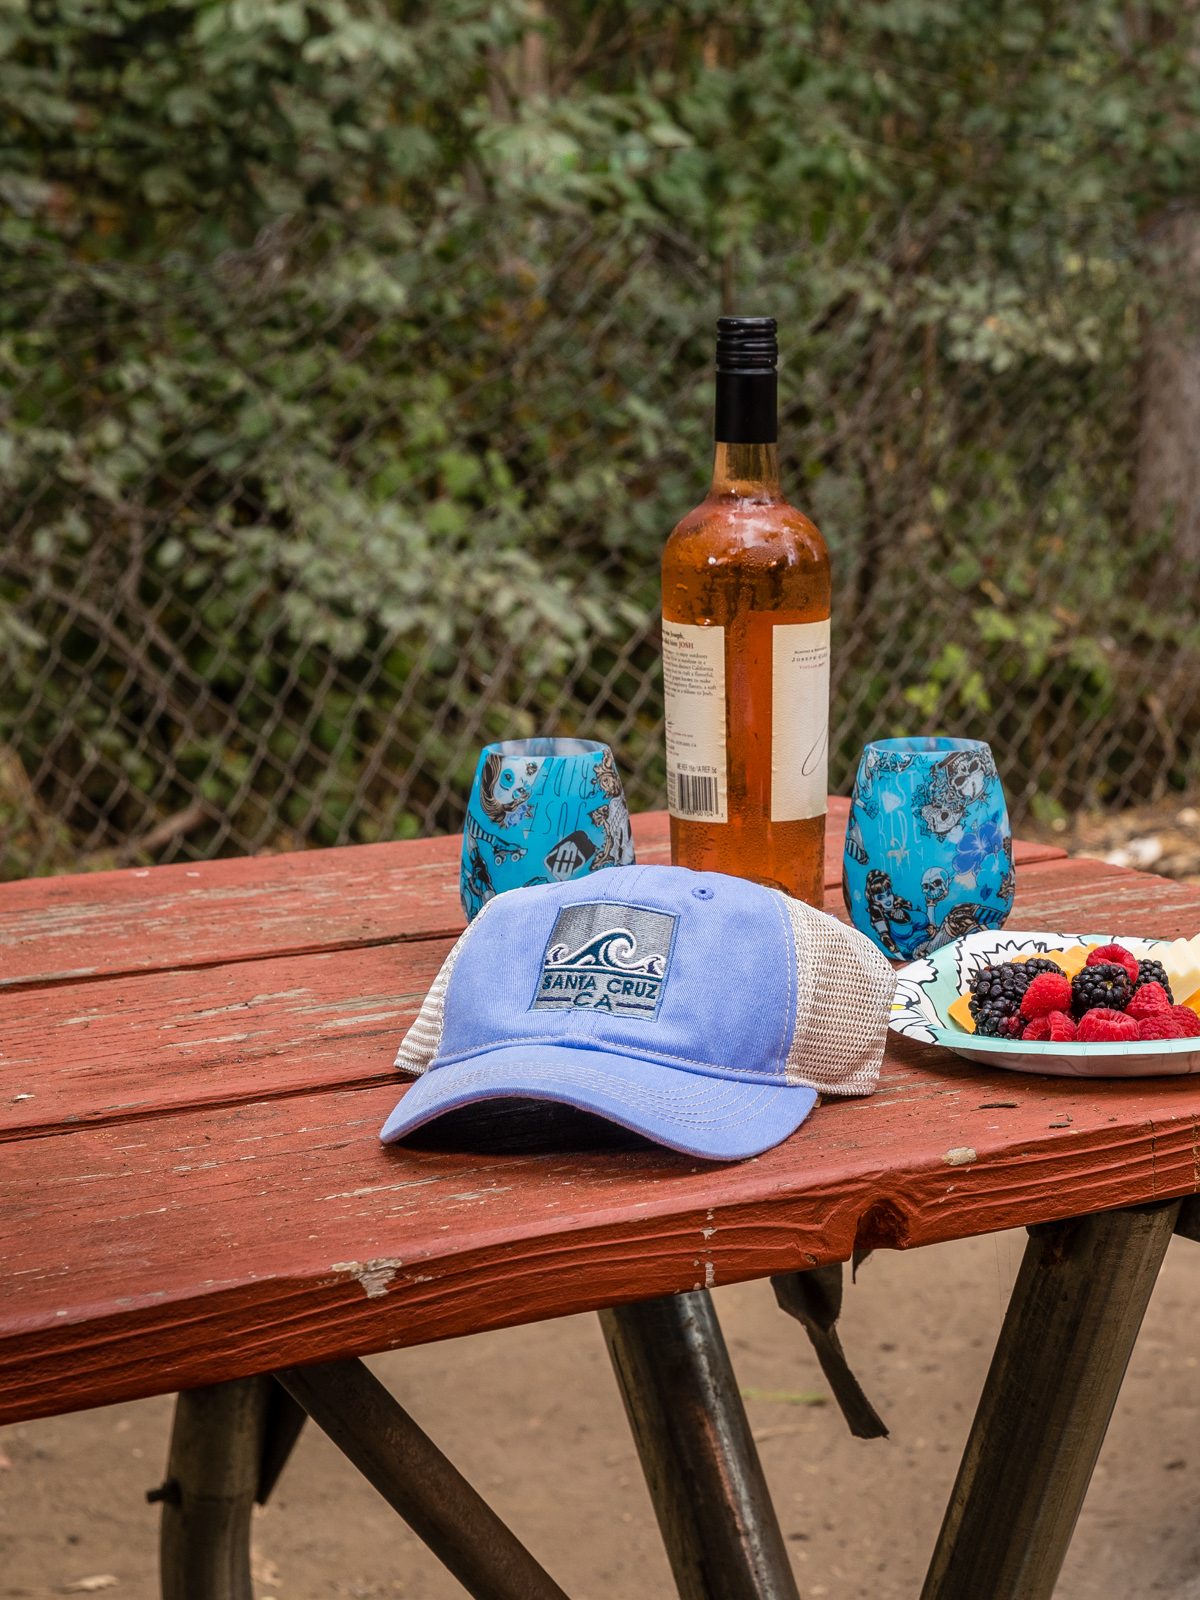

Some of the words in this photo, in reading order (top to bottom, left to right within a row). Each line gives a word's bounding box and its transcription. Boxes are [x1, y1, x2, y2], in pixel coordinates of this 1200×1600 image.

[678, 641, 694, 649] JOSH
[535, 757, 590, 800] RIDE
[523, 801, 587, 837] JUST
[542, 974, 598, 991] SANTA
[606, 978, 658, 999] CRUZ
[573, 992, 612, 1011] CA
